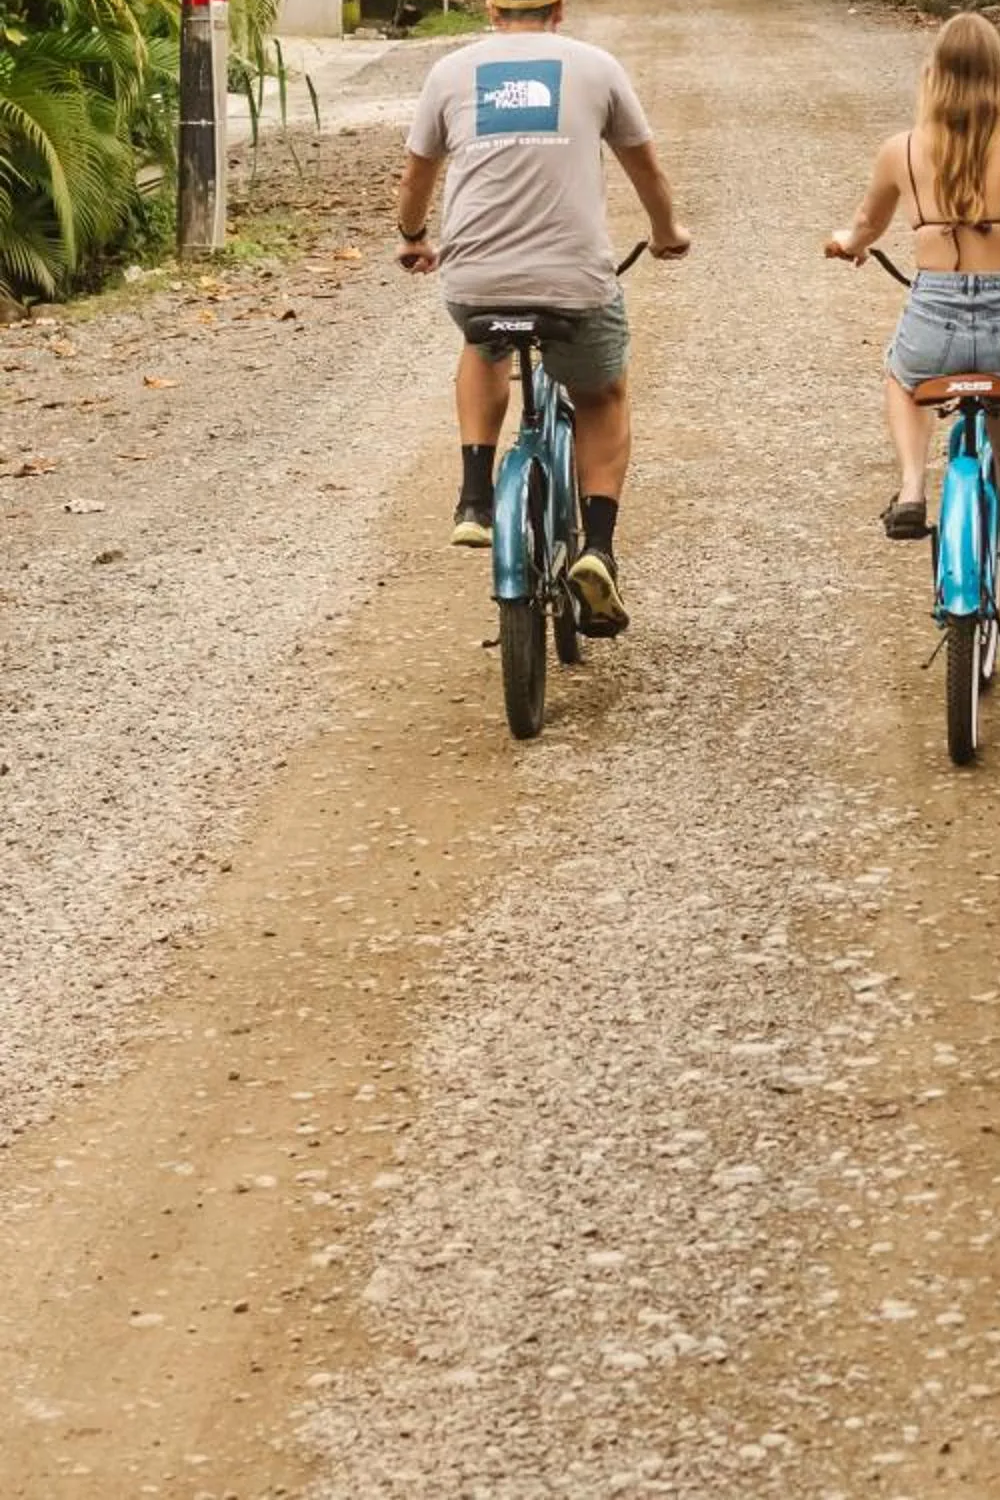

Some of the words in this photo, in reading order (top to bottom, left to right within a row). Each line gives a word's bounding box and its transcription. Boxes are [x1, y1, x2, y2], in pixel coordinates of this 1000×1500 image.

[502, 81, 528, 91] THE
[484, 89, 528, 104] NORTH
[495, 99, 528, 109] FACE
